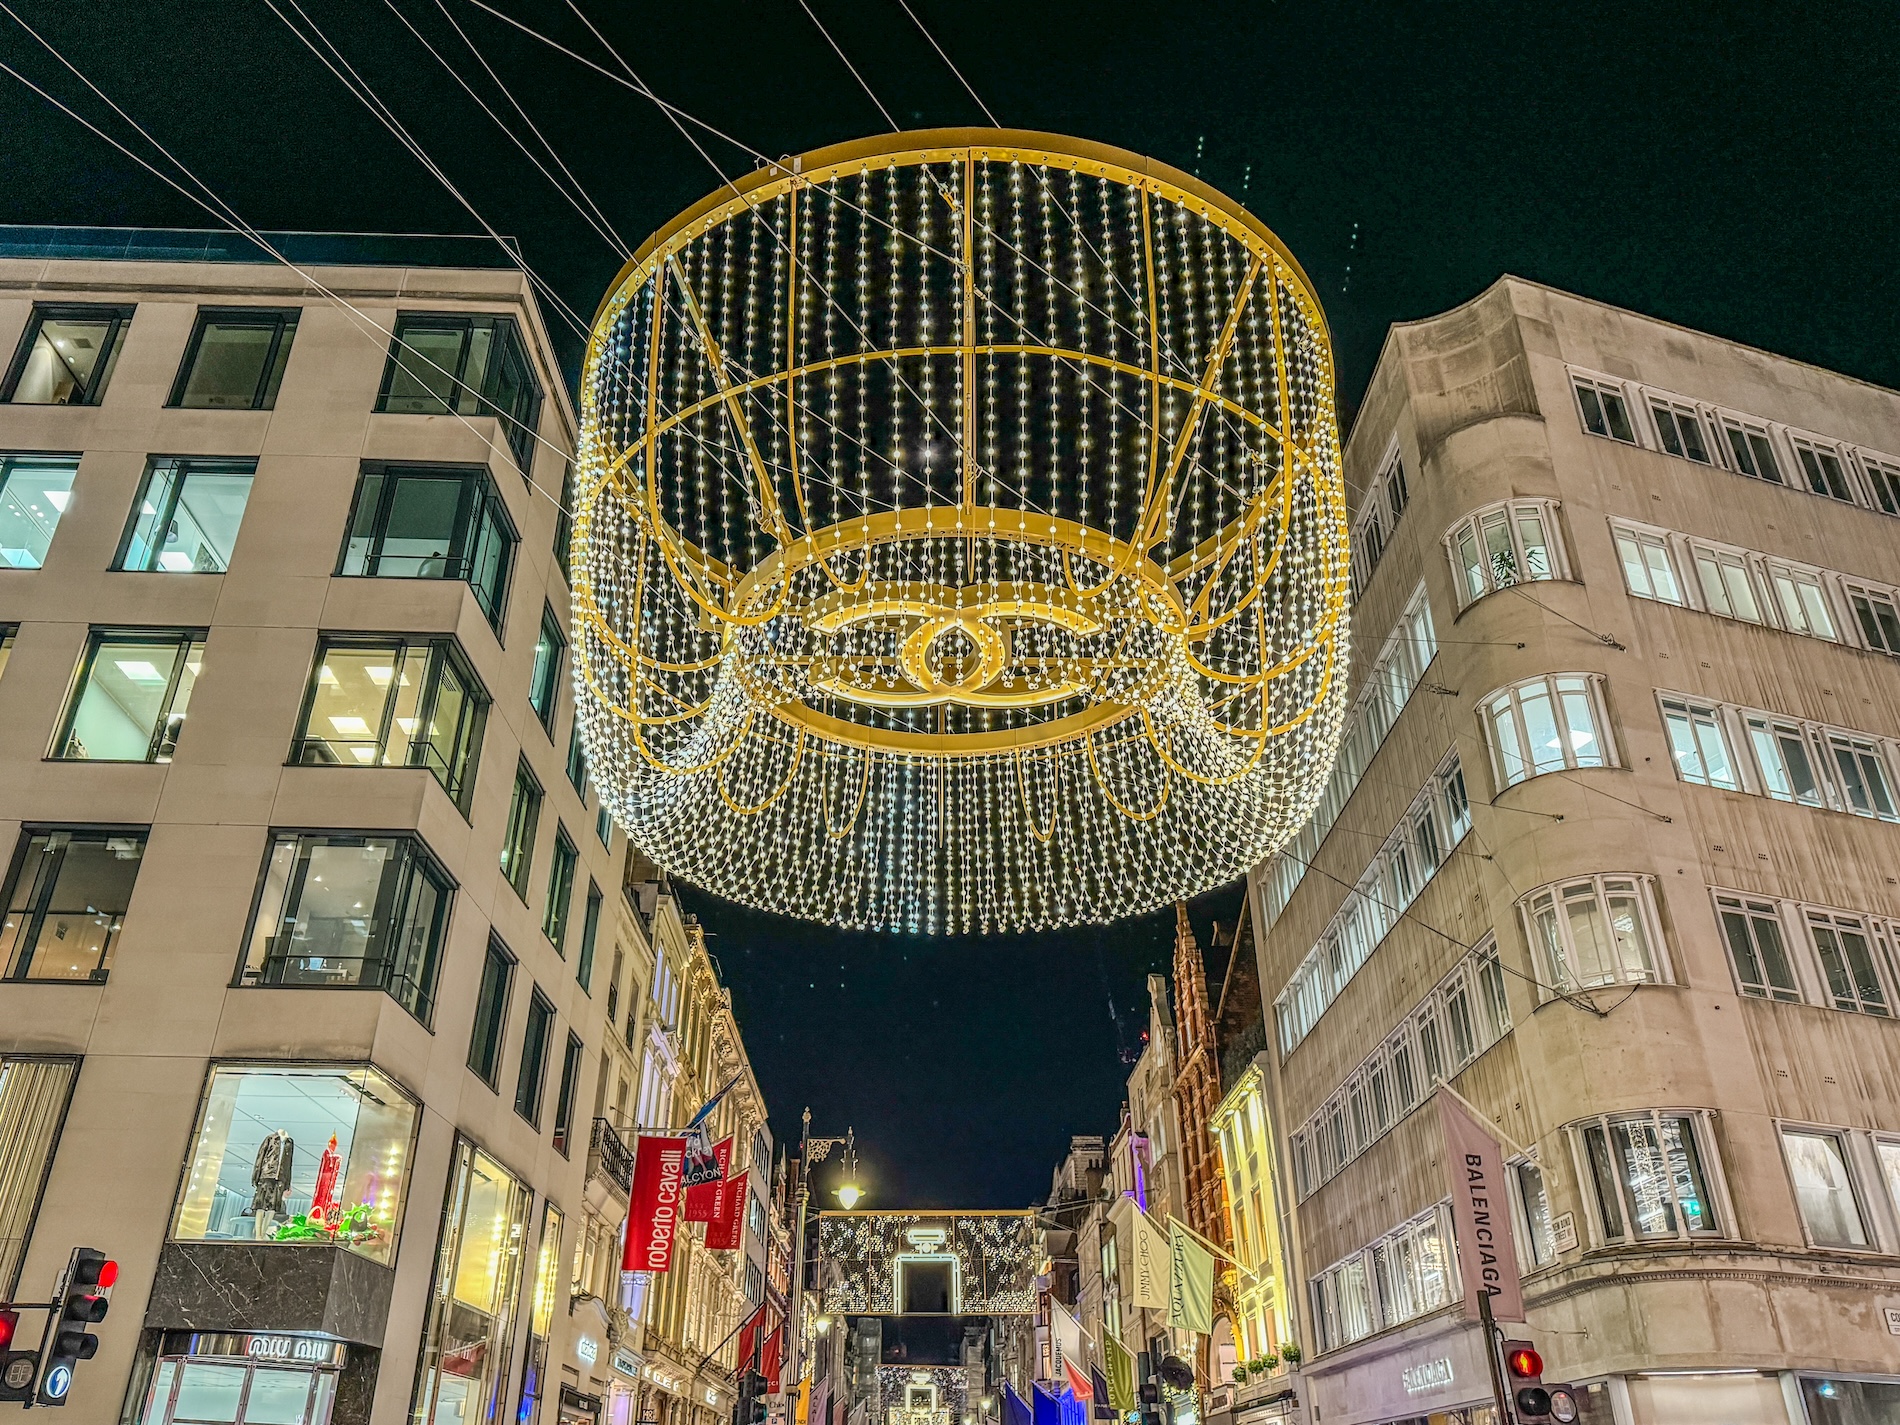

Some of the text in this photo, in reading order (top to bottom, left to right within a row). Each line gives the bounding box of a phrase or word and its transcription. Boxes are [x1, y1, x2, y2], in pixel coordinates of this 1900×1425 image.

[681, 1168, 721, 1184] ALCYON
[685, 1146, 713, 1160] ckney
[713, 1148, 727, 1218] RICHD GREEN
[646, 1149, 683, 1269] roberto cavalli
[731, 1181, 744, 1246] RICHARD GREEN
[1465, 1153, 1502, 1298] BALENCIAGA
[1139, 1229, 1150, 1300] JIMMY CHOO
[1171, 1234, 1185, 1325] AQUAZZURA
[1105, 1340, 1117, 1406] LONGCHAMP
